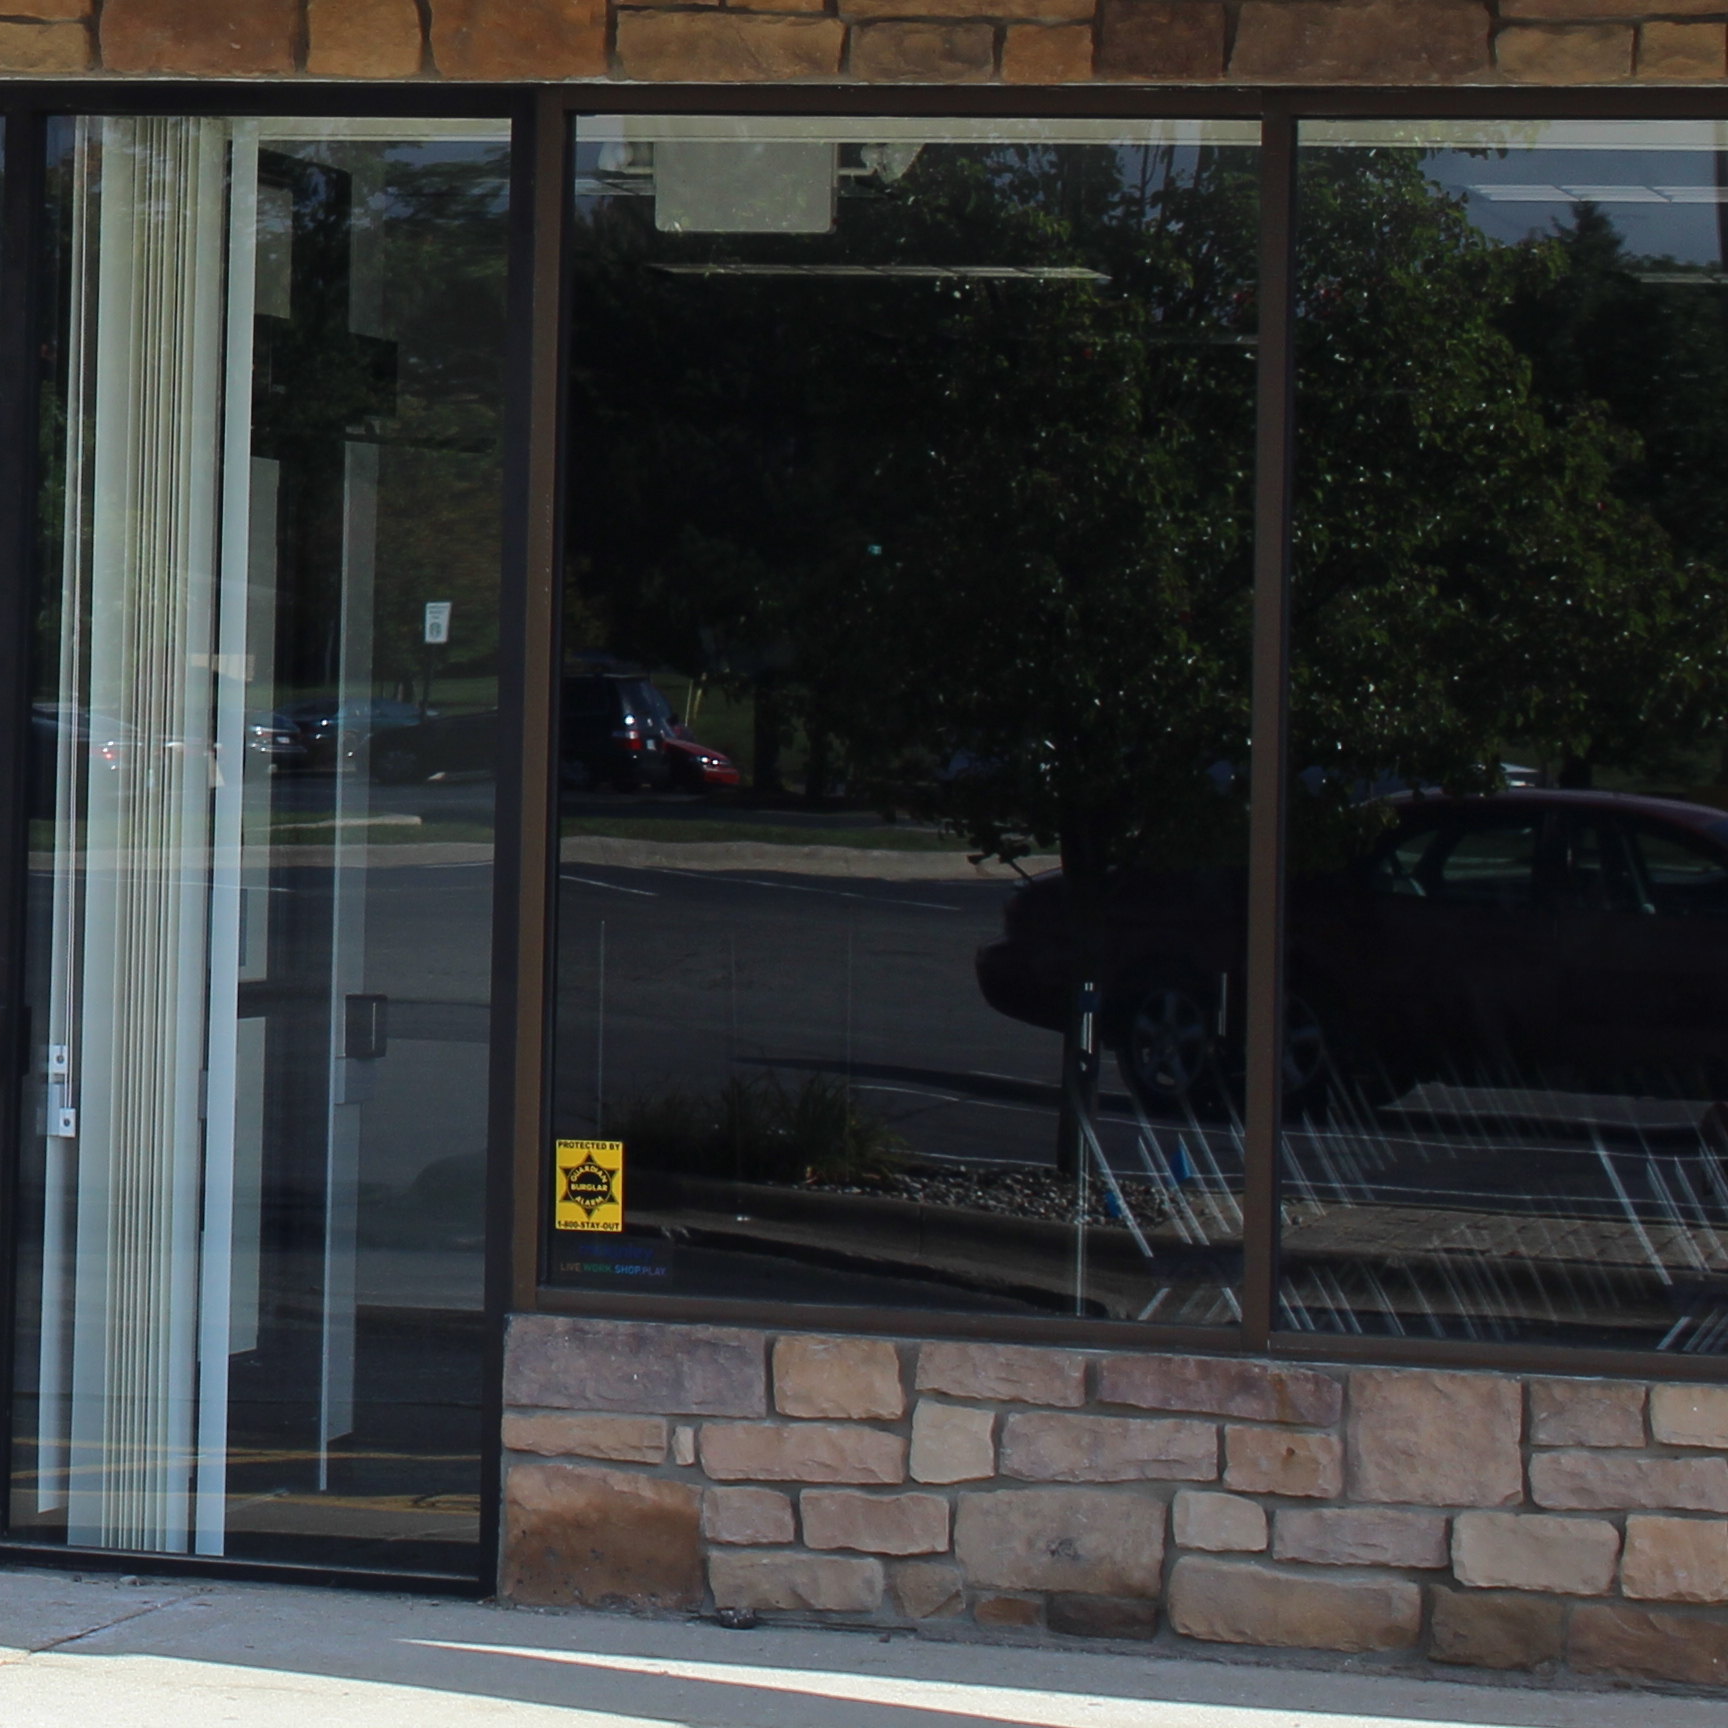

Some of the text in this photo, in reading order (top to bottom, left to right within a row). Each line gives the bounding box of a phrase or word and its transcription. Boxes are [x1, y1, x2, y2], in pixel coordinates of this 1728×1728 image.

[558, 1141, 621, 1151] PROTECTED BY
[570, 1165, 608, 1183] GUARDIAN
[570, 1183, 608, 1192] BURGLAR
[575, 1195, 604, 1207] ALARM
[557, 1220, 620, 1230] 1-800-STAY-OUT
